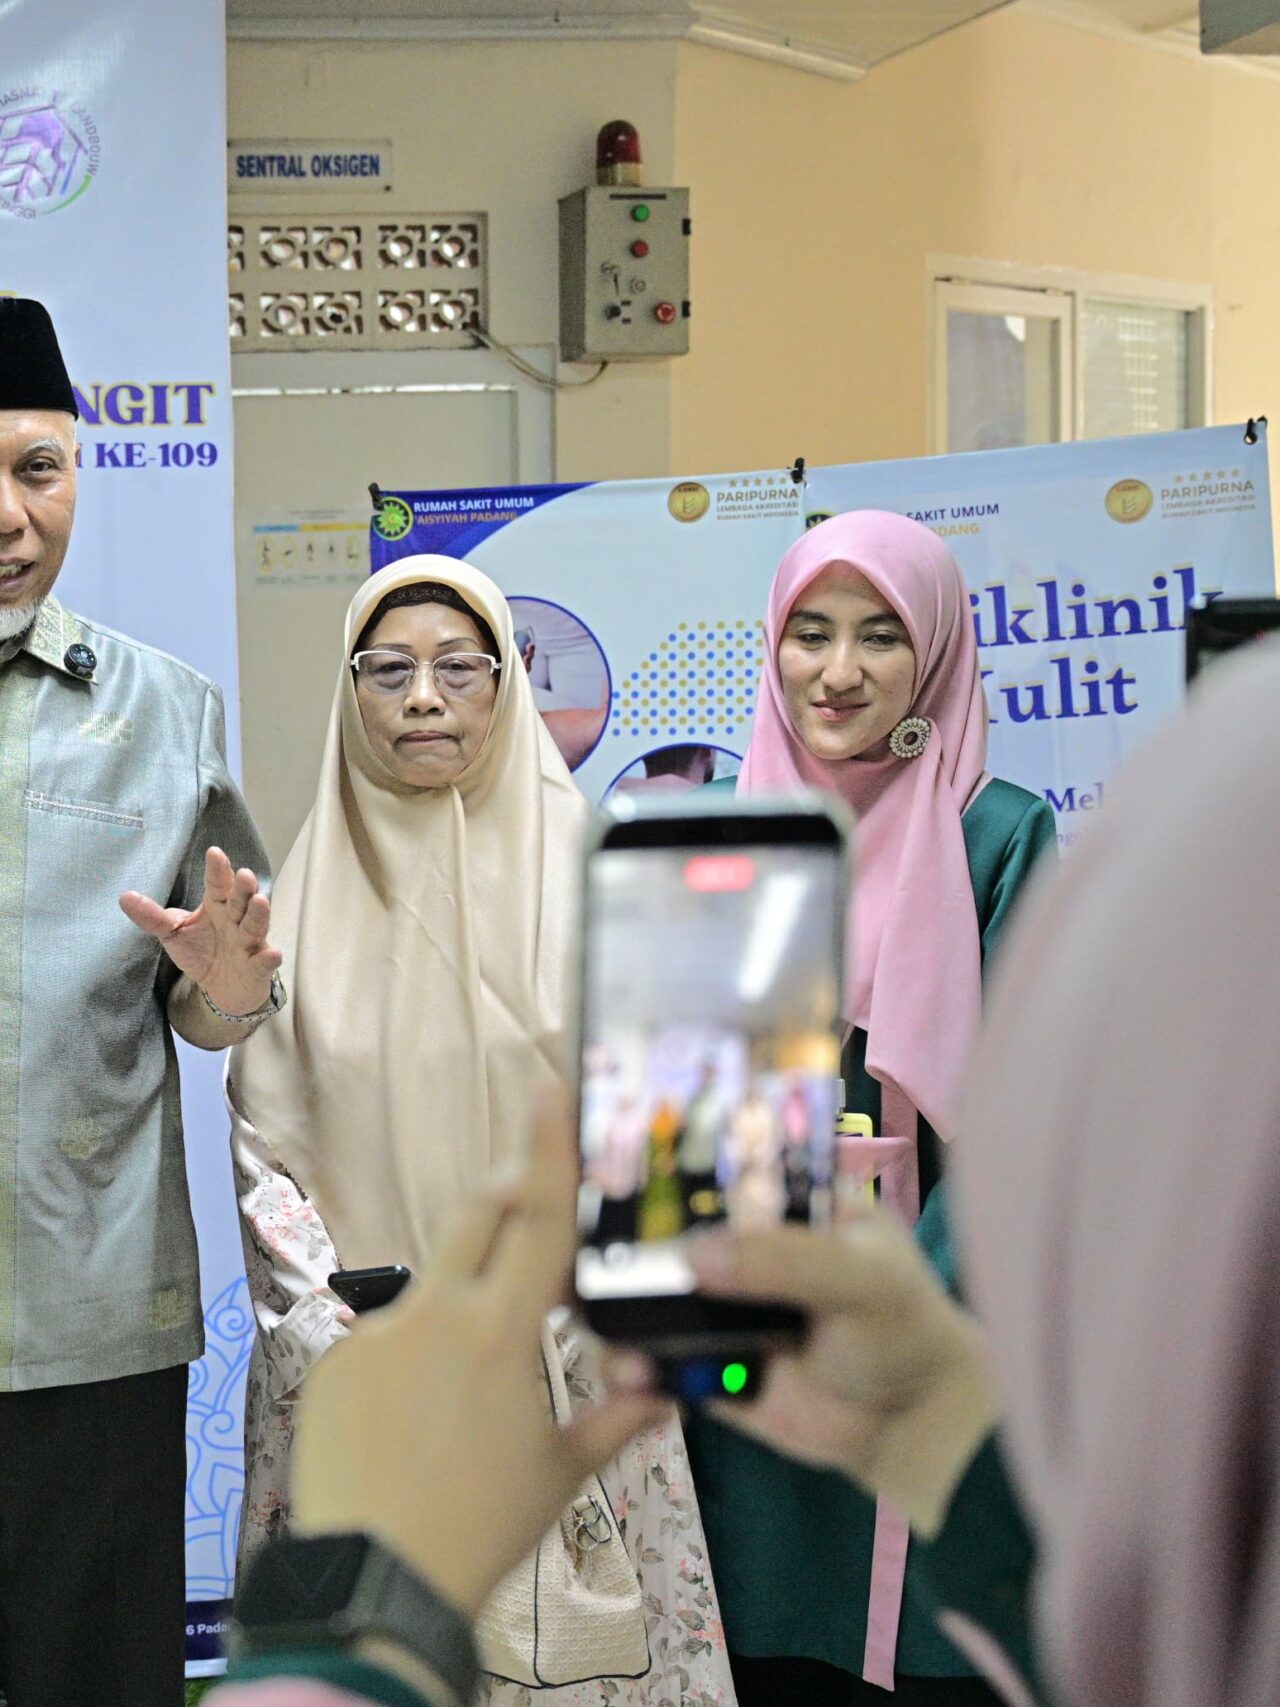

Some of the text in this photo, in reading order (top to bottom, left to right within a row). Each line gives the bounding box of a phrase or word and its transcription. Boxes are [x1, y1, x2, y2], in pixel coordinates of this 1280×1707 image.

[236, 153, 381, 178] SENTRAL OKSIGEN
[72, 383, 215, 425] NGIT
[95, 442, 218, 468] KE-109
[717, 487, 799, 503] PARIPURNA
[1160, 479, 1255, 500] PARIPURNA
[413, 497, 535, 513] RUMAH SAKIT UMUM
[905, 503, 1000, 522] SAKIT UMUM
[470, 511, 518, 523] PADANG
[930, 523, 980, 537] DANG
[970, 565, 1224, 648] iklinik
[980, 655, 1139, 724] ulit
[1041, 780, 1105, 813] Mel
[185, 1624, 195, 1636] 6
